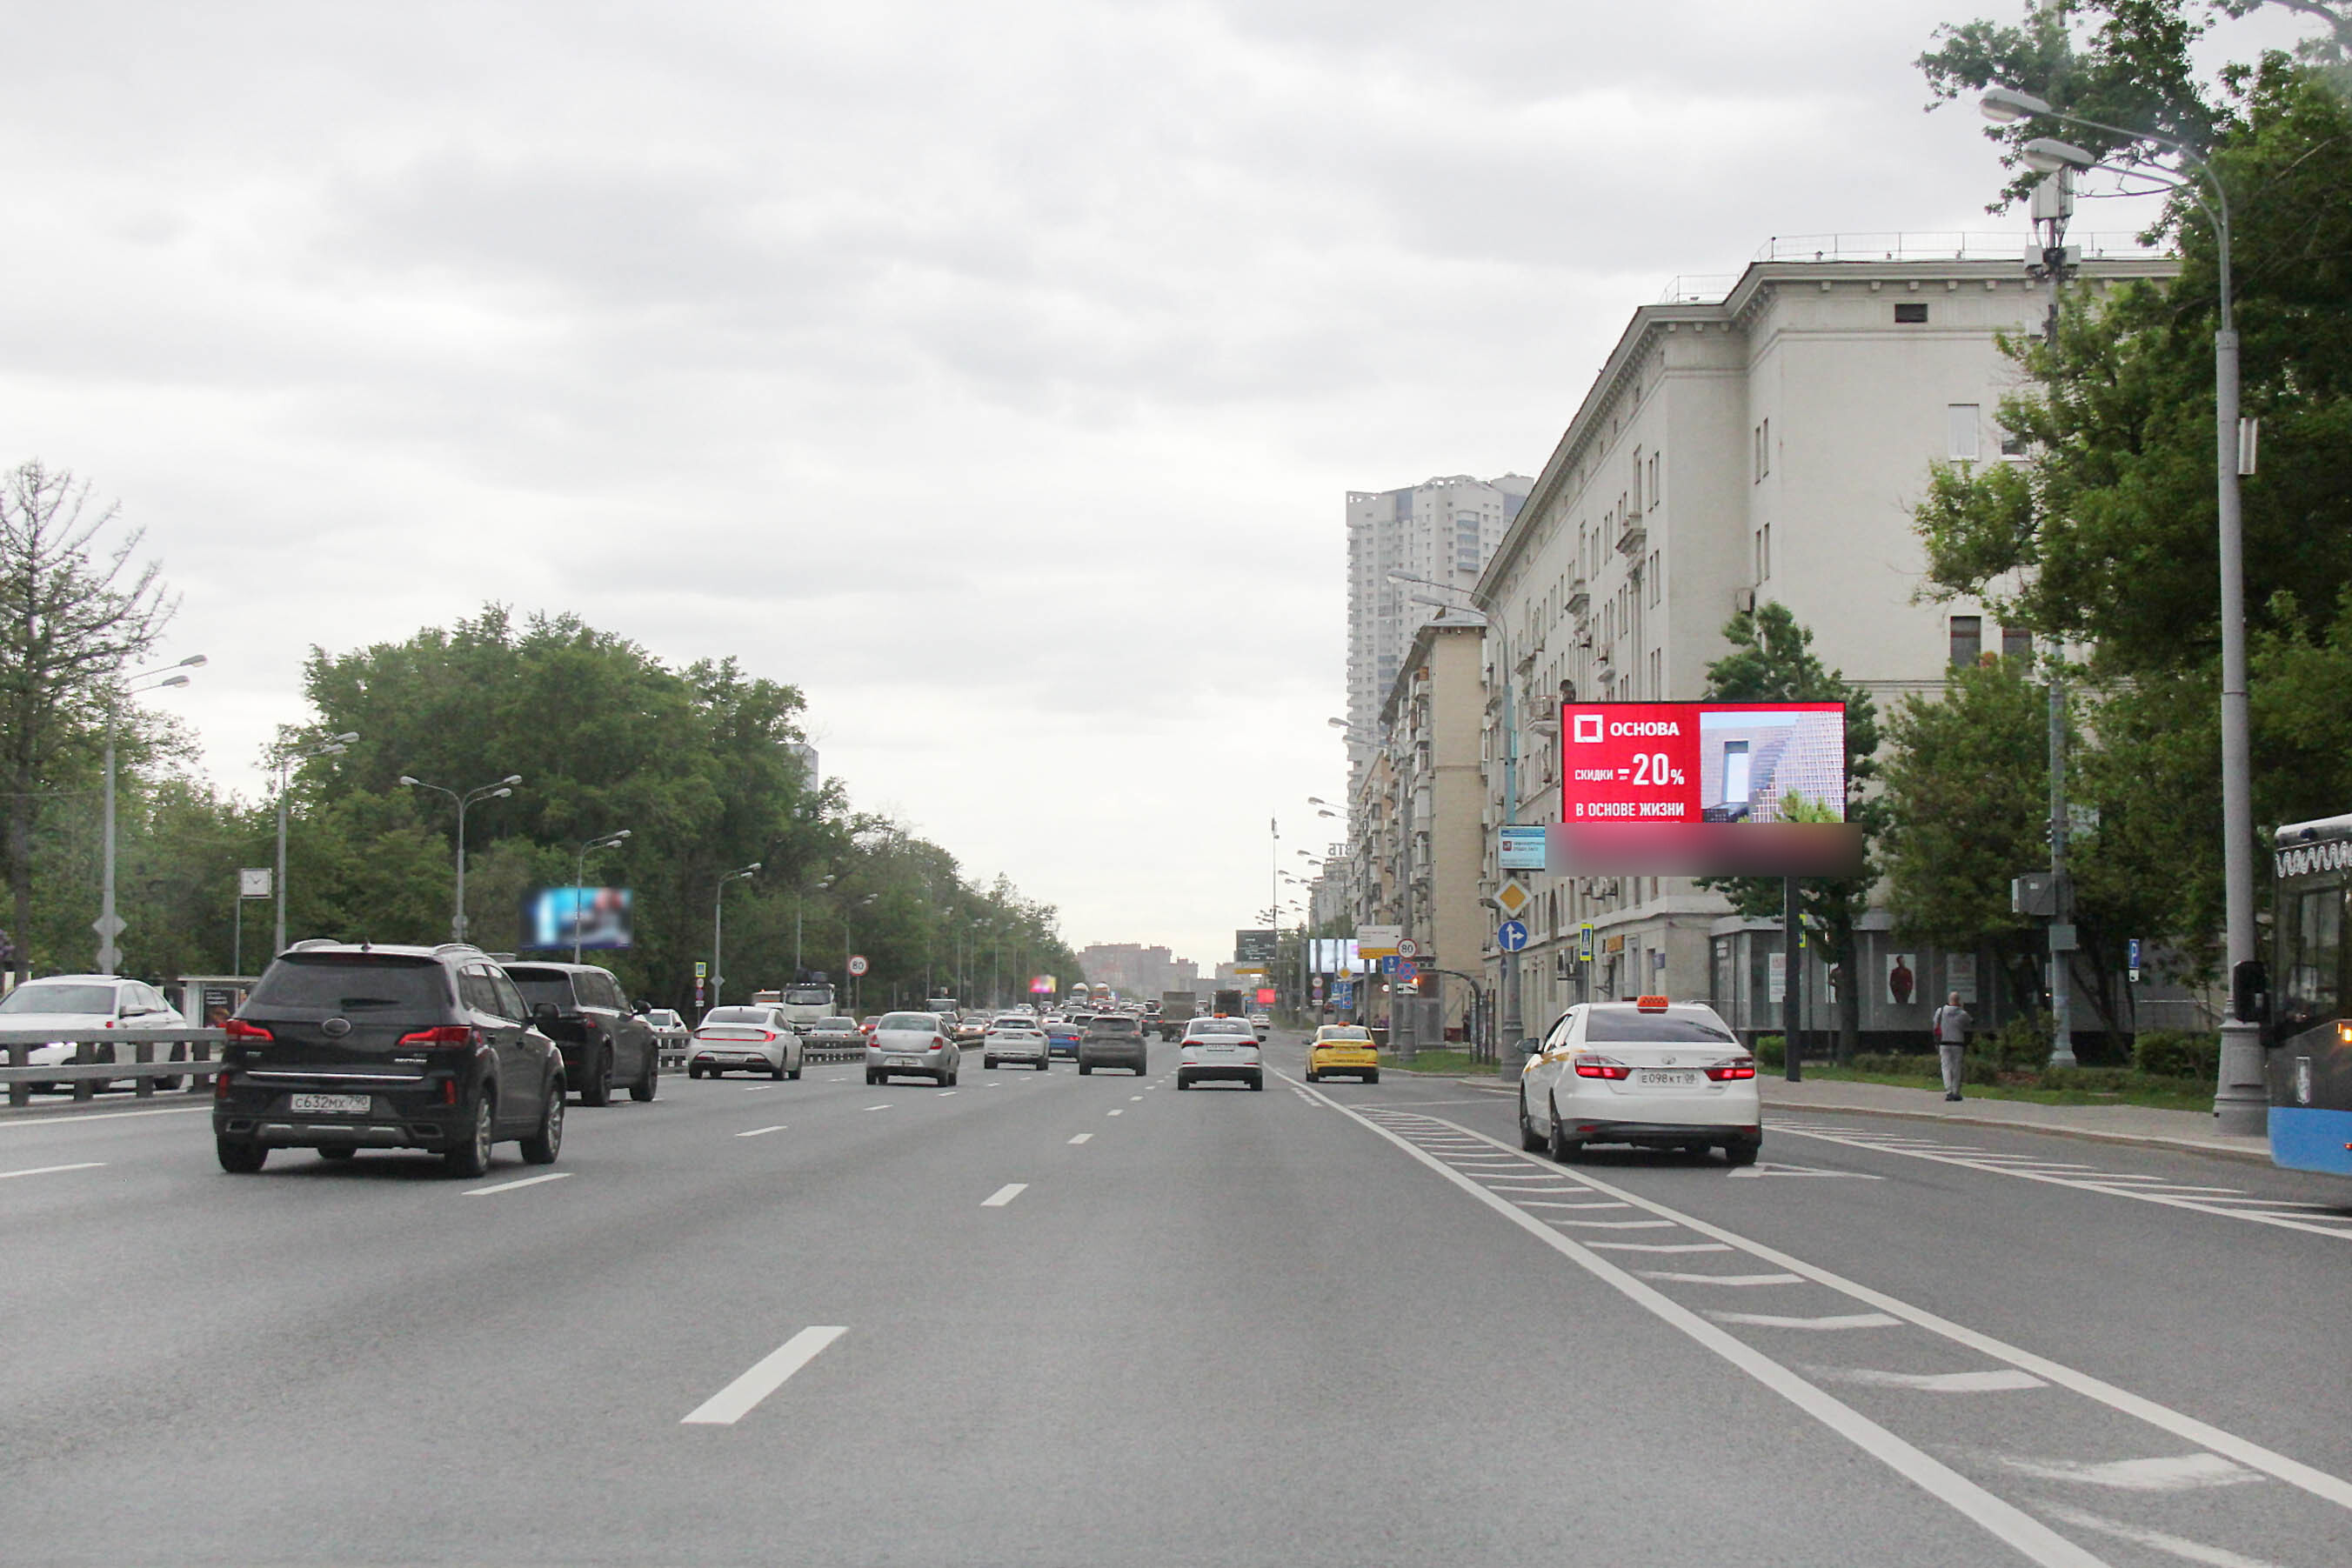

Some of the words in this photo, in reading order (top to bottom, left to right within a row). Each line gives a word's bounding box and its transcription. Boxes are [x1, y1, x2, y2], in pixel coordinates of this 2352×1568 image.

[1609, 721, 1680, 737] ОСНОВА
[1574, 769, 1614, 782] СКИДКИ
[1575, 802, 1584, 817] В
[1587, 802, 1636, 817] ОСНОВЕ
[1639, 802, 1685, 817] ЖИЗНИ
[1400, 944, 1413, 953] 80
[852, 960, 865, 970] 80
